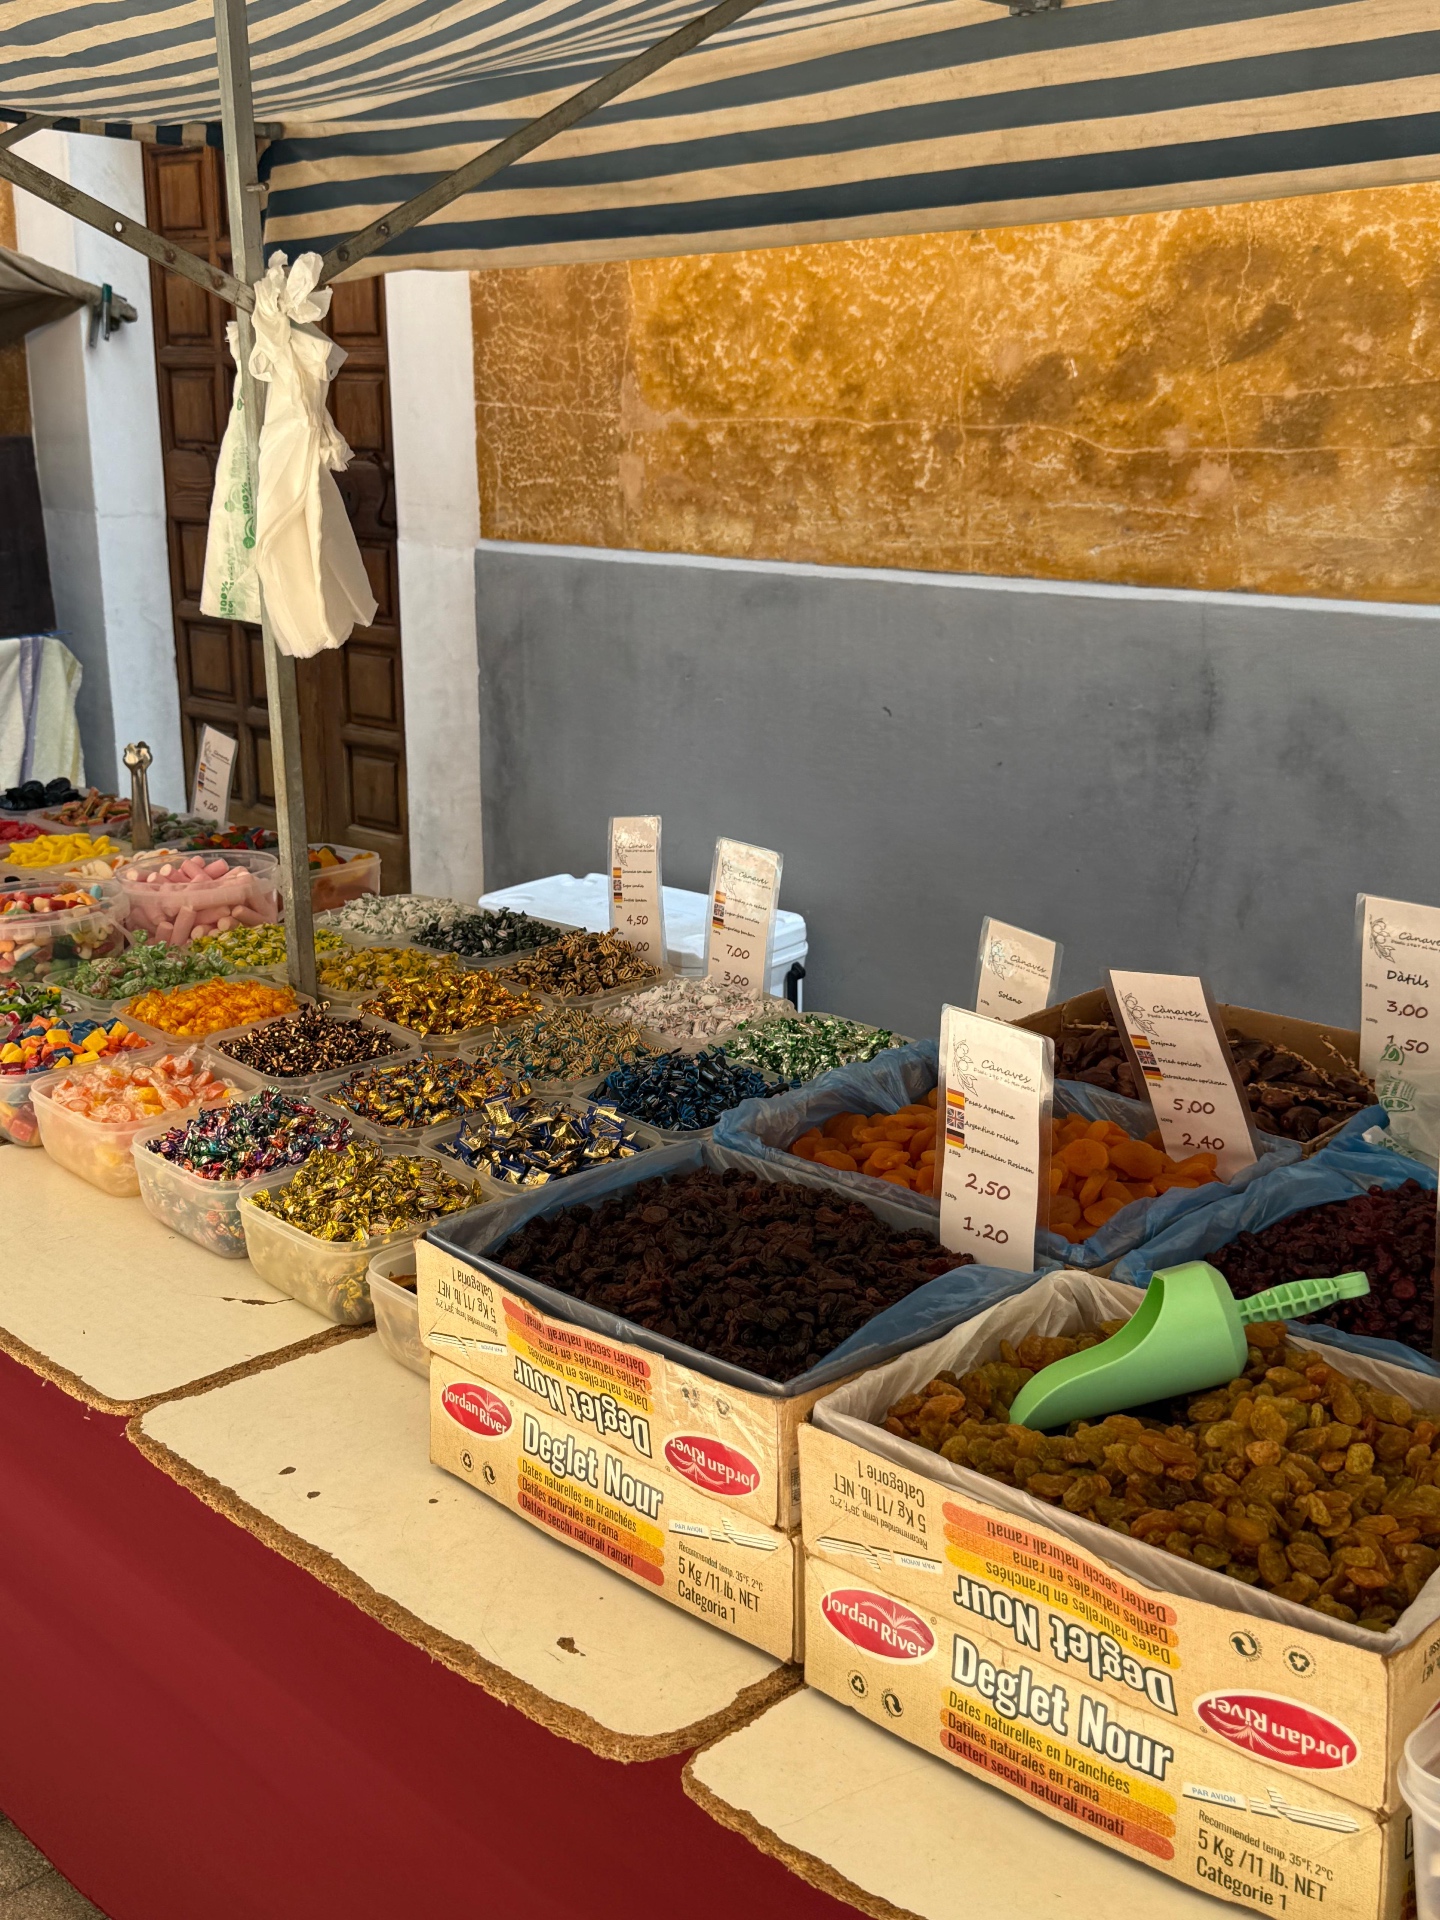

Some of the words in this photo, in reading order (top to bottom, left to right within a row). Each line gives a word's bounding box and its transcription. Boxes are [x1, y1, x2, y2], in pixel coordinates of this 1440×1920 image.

[220, 580, 228, 612] 100%
[626, 914, 649, 926] 4,50
[634, 942, 650, 953] ,00
[726, 944, 750, 960] 7,00
[1399, 931, 1440, 947] Cànave
[724, 970, 749, 986] 3,00
[1386, 970, 1429, 988] Dàtils
[998, 990, 1022, 1004] Solano
[1386, 1000, 1428, 1019] 3,00
[1152, 1005, 1201, 1018] Cànaves
[1387, 1035, 1429, 1054] 1,50
[981, 1059, 1032, 1083] Cànaves
[1173, 1098, 1215, 1114] 5,00
[964, 1120, 995, 1136] Argentine
[996, 1132, 1020, 1145] raisins
[1182, 1133, 1224, 1150] 2,40
[965, 1172, 1011, 1200] 2,50
[963, 1216, 1009, 1244] 1,20
[438, 1279, 450, 1300] NET
[457, 1270, 494, 1303] Categoria
[477, 1298, 489, 1320] Kg
[491, 1307, 497, 1324] 5
[547, 1327, 582, 1347] naturali
[584, 1341, 611, 1358] secchi
[560, 1350, 571, 1360] en
[574, 1356, 614, 1376] naturales
[614, 1350, 645, 1375] Datteri
[514, 1355, 567, 1416] Nour
[566, 1366, 577, 1378] en
[579, 1372, 621, 1396] naturelles
[445, 1386, 479, 1416] Jordan
[480, 1407, 507, 1434] River
[624, 1390, 648, 1411] Dates
[566, 1385, 652, 1459] Deglet
[523, 1412, 599, 1488] Deglet
[604, 1453, 664, 1520] Nour
[670, 1438, 705, 1467] River
[708, 1458, 756, 1492] Jordan
[858, 1460, 864, 1478] 1
[523, 1459, 542, 1482] Dates
[544, 1476, 582, 1503] naturelles
[584, 1496, 593, 1510] en
[596, 1498, 637, 1533] branchées
[834, 1473, 855, 1499] NET
[858, 1484, 872, 1507] lb.
[867, 1464, 925, 1508] Categorie
[522, 1477, 546, 1502] Datiles
[548, 1495, 583, 1524] naturales
[586, 1515, 595, 1528] en
[598, 1521, 619, 1541] rama
[876, 1493, 894, 1516] /11
[898, 1500, 914, 1527] Kg
[522, 1494, 546, 1520] Datteri
[547, 1513, 572, 1534] secchi
[574, 1527, 604, 1551] naturali
[607, 1542, 633, 1568] ramati
[880, 1519, 928, 1550] Recommended
[918, 1514, 926, 1534] 5
[987, 1520, 1029, 1547] ramati
[678, 1541, 717, 1569] Recommended
[1012, 1550, 1045, 1573] rama
[1032, 1539, 1079, 1569] naturali
[678, 1556, 685, 1575] 5
[688, 1561, 702, 1587] Kg
[704, 1571, 720, 1593] /11
[724, 1580, 736, 1601] lb.
[739, 1588, 760, 1612] NET
[985, 1561, 1049, 1600] branchées
[1049, 1566, 1064, 1582] en
[1082, 1562, 1118, 1594] secchi
[678, 1579, 727, 1620] Categoria
[731, 1607, 736, 1624] 1
[1053, 1588, 1068, 1606] en
[1068, 1574, 1120, 1616] naturales
[1120, 1592, 1166, 1623] Datteri
[826, 1592, 879, 1633] Jordan
[881, 1622, 925, 1657] River
[953, 1574, 1040, 1652] Nour
[1072, 1596, 1128, 1638] naturelles
[1123, 1609, 1168, 1644] Datiles
[1049, 1613, 1179, 1716] Deglet
[1132, 1638, 1170, 1664] Dates
[952, 1633, 1069, 1736] Deglet
[1077, 1694, 1174, 1782] Nour
[1207, 1697, 1267, 1733] River
[949, 1690, 981, 1720] Dates
[984, 1711, 1042, 1752] naturelles
[1046, 1741, 1061, 1759] en
[1065, 1749, 1130, 1794] branchées
[1272, 1721, 1349, 1766] Jordan
[948, 1711, 987, 1746] Datiles
[990, 1736, 1045, 1776] naturales
[1049, 1767, 1064, 1786] en
[1067, 1775, 1100, 1803] rama
[948, 1733, 988, 1767] Datteri
[991, 1759, 1027, 1788] secchi
[1030, 1780, 1078, 1814] naturali
[1081, 1804, 1124, 1836] ramati
[1192, 1787, 1209, 1797] PAR
[1210, 1791, 1236, 1803] AVION
[1199, 1809, 1260, 1848] Recommended
[1262, 1841, 1287, 1862] temp.
[1315, 1864, 1333, 1881] 2°C
[1198, 1828, 1208, 1850] 5
[1213, 1836, 1235, 1867] Kg
[1239, 1850, 1263, 1878] /11
[1270, 1862, 1288, 1889] lb.
[1294, 1873, 1327, 1902] NET
[1196, 1856, 1274, 1905] Categorie
[1279, 1894, 1287, 1911] 1
